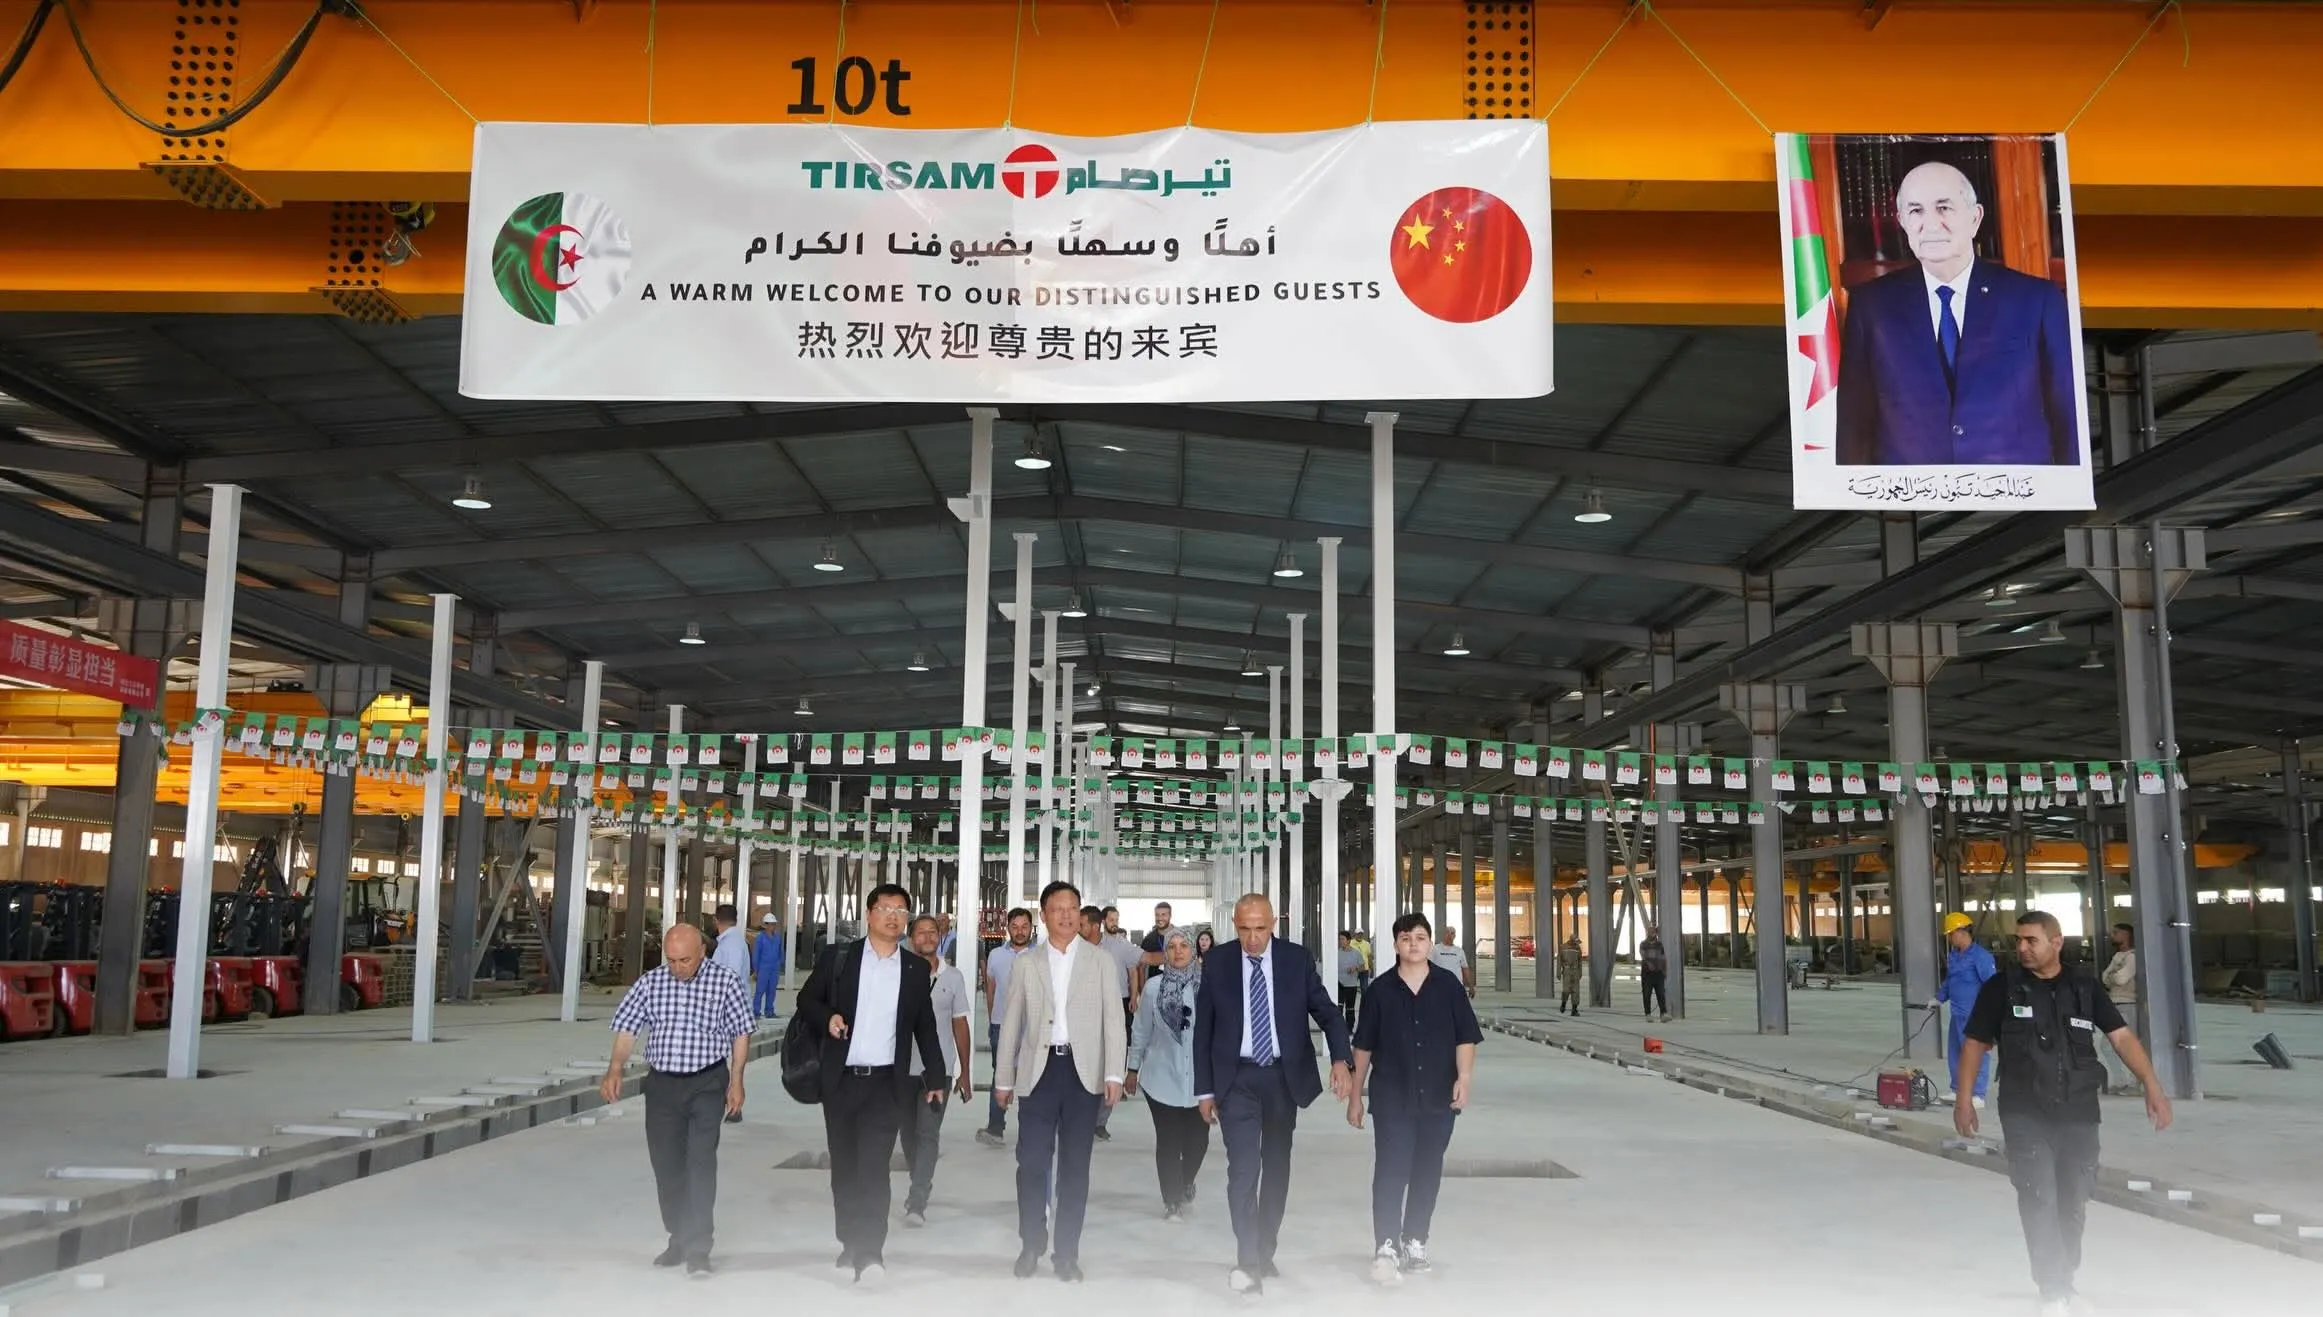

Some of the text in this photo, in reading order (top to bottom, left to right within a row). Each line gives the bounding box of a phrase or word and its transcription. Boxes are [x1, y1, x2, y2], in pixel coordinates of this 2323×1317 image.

[787, 56, 912, 116] 10t
[801, 161, 995, 191] TIRSAM
[1066, 159, 1232, 197] تيرصام
[745, 231, 864, 264] الكرام
[888, 231, 1033, 267] بضيوفنا
[640, 279, 1381, 307] A WARM WELCOME TO OUR DISTINGUISHED GUESTS
[797, 320, 1219, 362] 热烈欢迎尊贵的来宾
